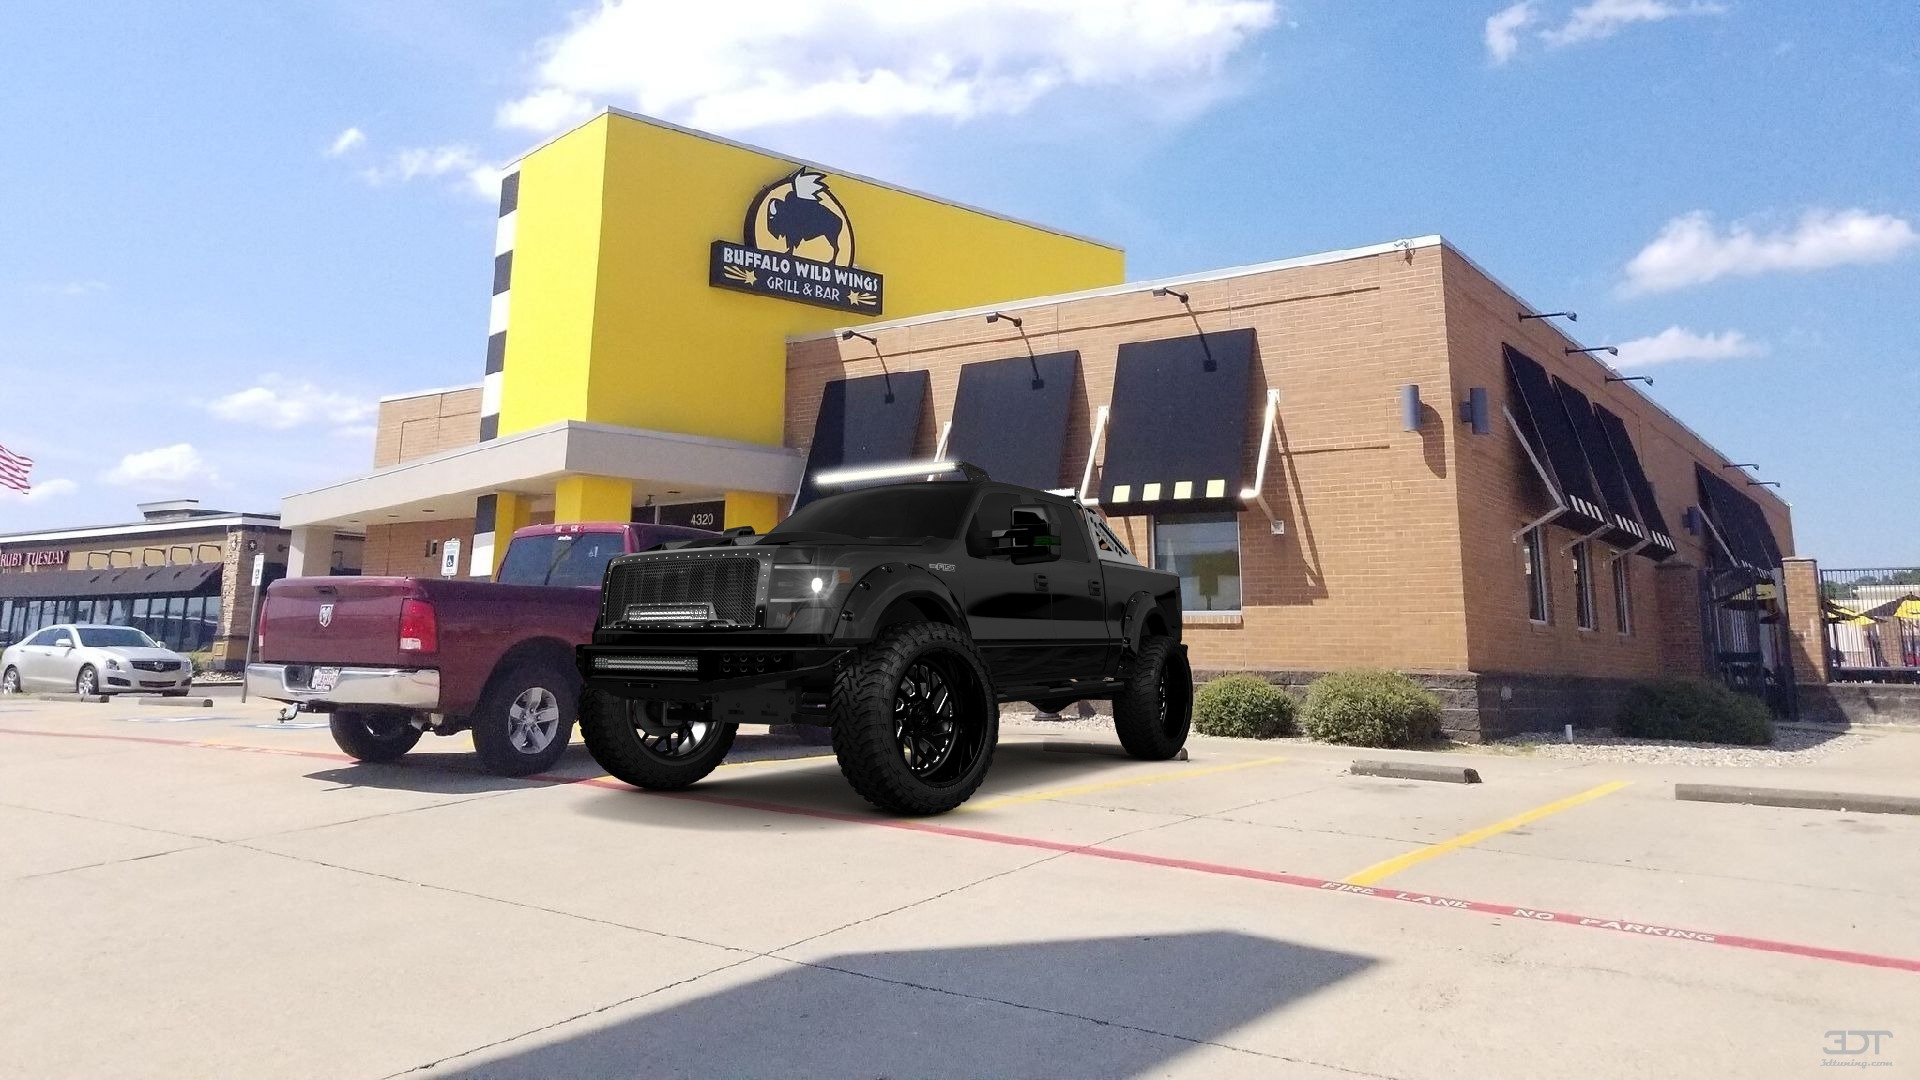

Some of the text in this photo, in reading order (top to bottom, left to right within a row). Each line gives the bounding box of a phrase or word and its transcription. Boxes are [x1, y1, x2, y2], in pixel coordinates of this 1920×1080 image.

[723, 247, 878, 292] BUFFALO WILD WINGS
[766, 276, 840, 302] GRILL & BAR
[690, 512, 714, 526] 4320
[0, 550, 65, 567] RUBY TUESDAY
[1320, 882, 1472, 910] FIRE LANE
[1512, 908, 1716, 943] NO PARKING
